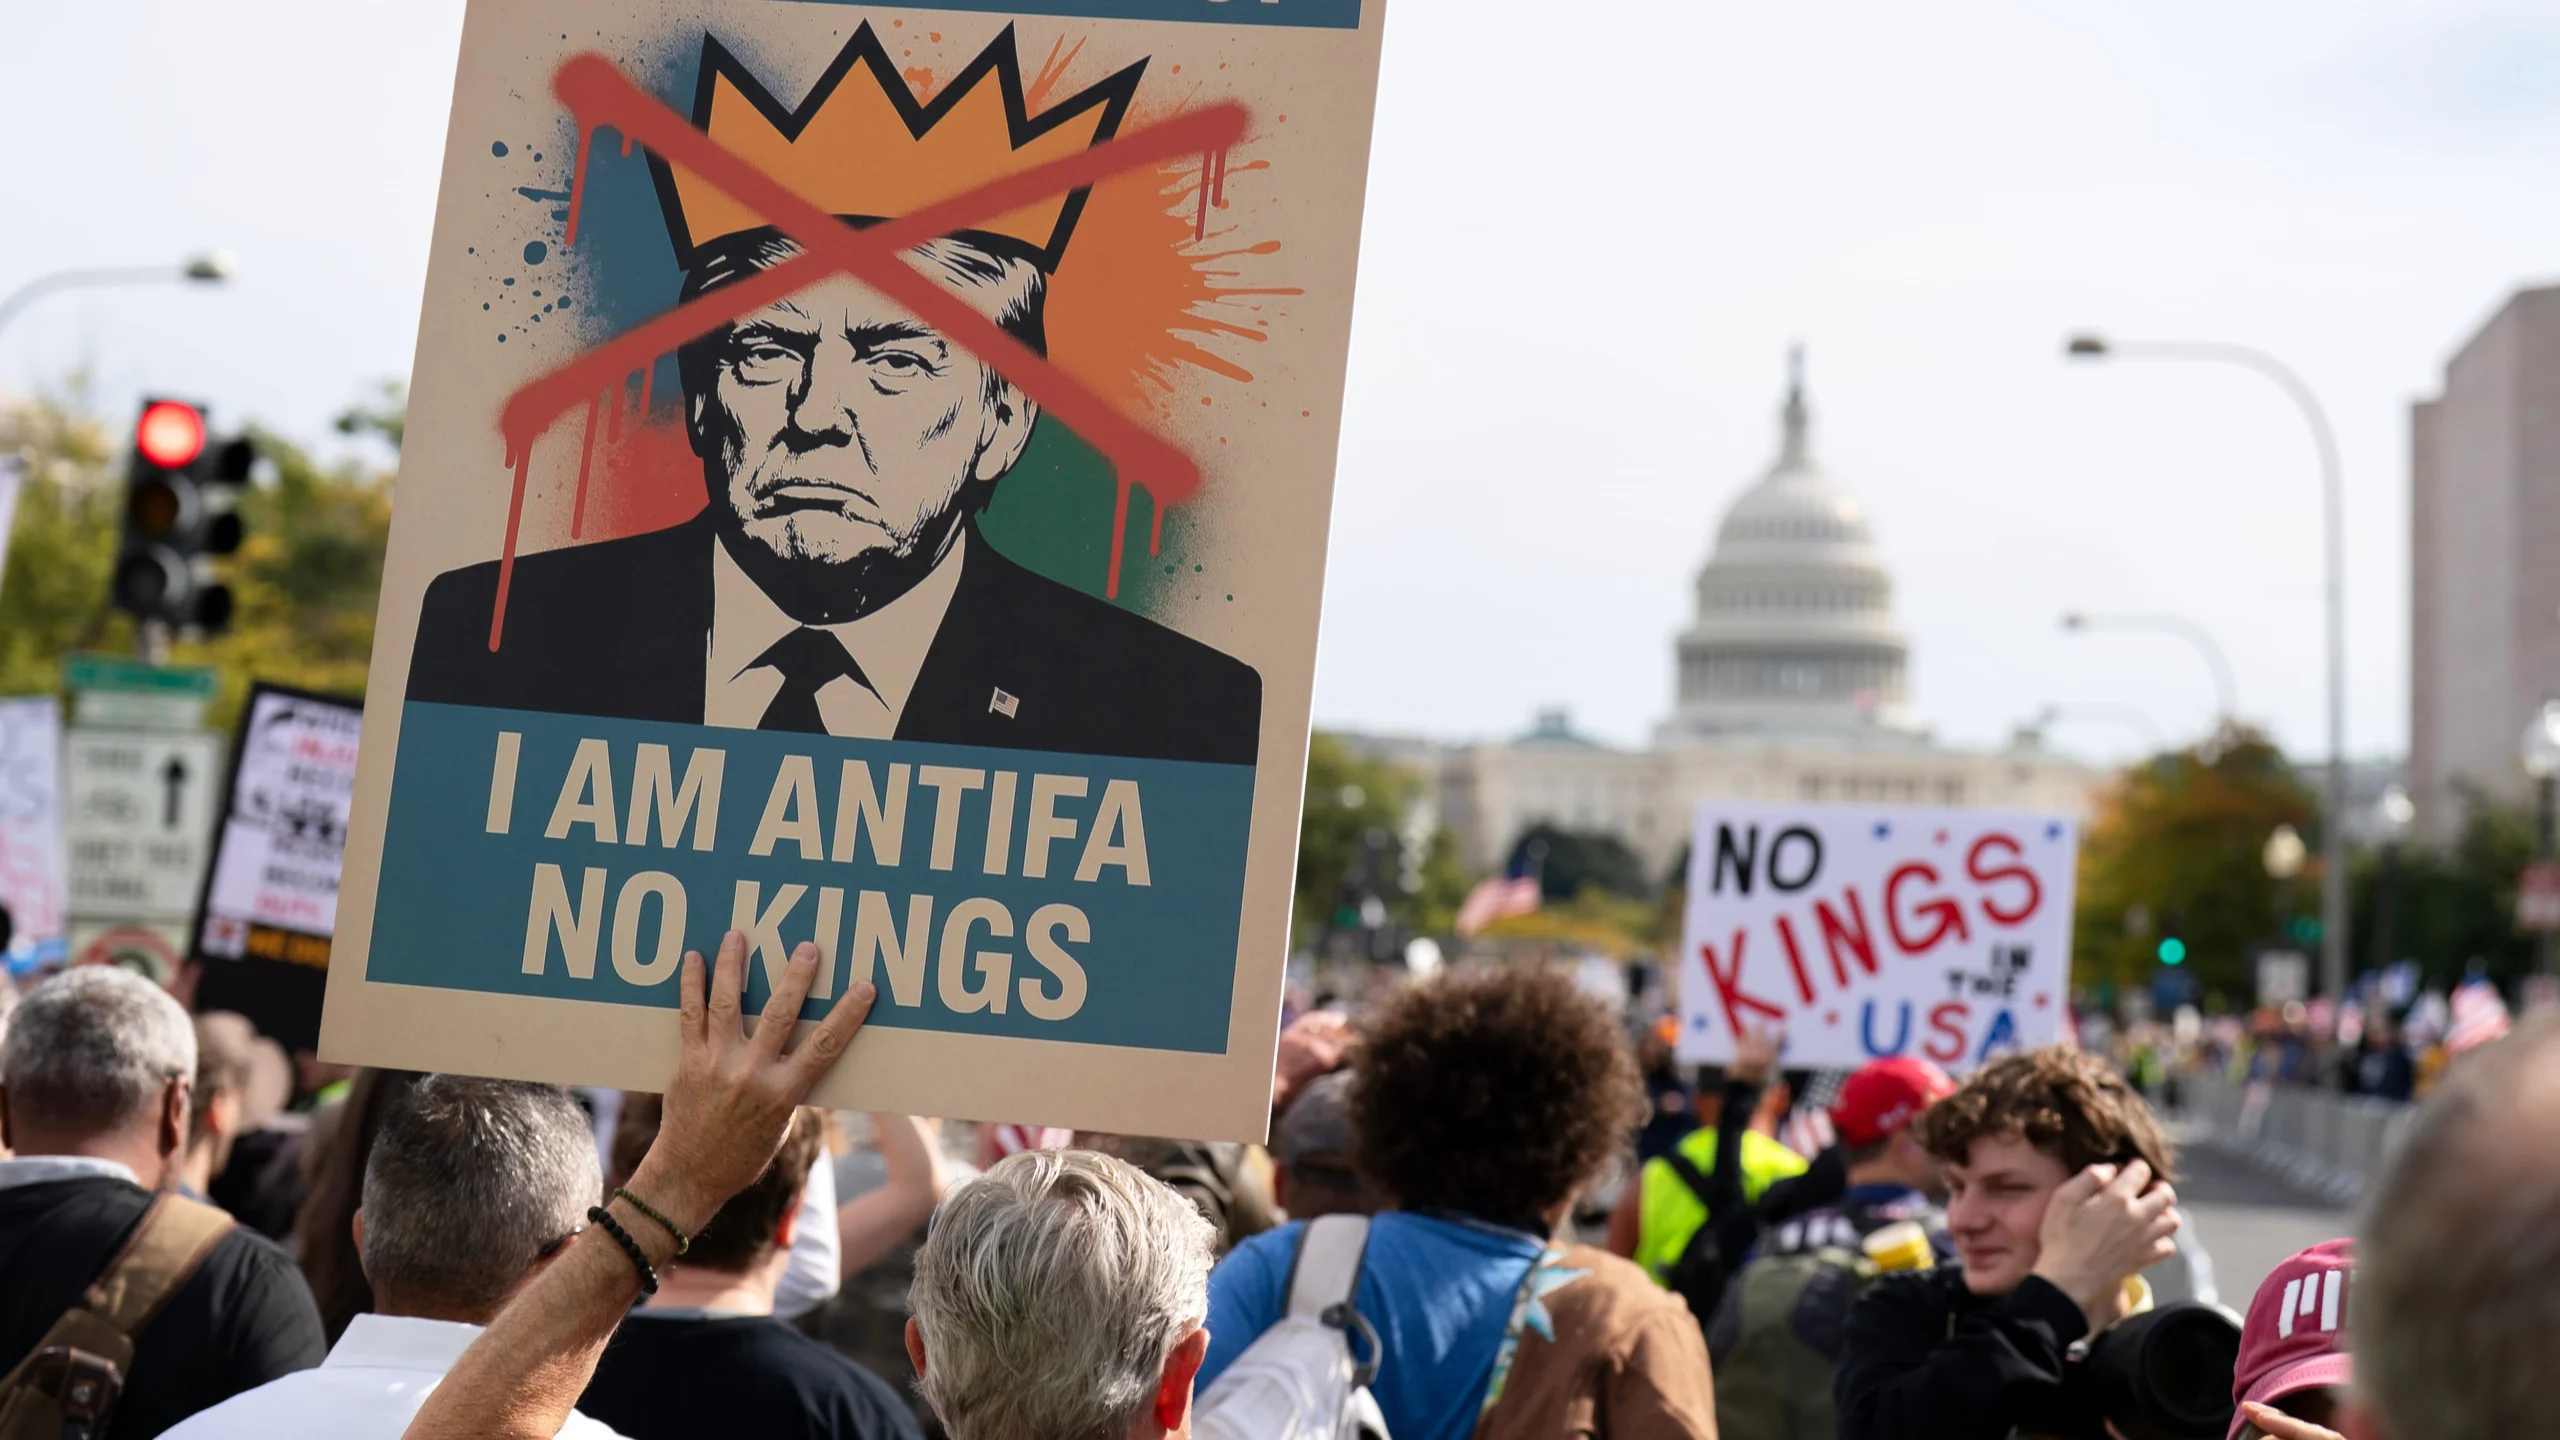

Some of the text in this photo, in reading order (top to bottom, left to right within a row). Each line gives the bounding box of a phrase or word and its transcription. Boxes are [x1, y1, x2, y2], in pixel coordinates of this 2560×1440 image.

[485, 731, 1152, 886] I AM ANTIFA
[1711, 822, 1824, 895] NO
[521, 862, 1092, 1021] NO KINGS
[1700, 832, 2043, 1041] KINGS
[1992, 945, 2033, 972] IN
[1946, 969, 2016, 998] THE
[1859, 998, 2022, 1064] USA
